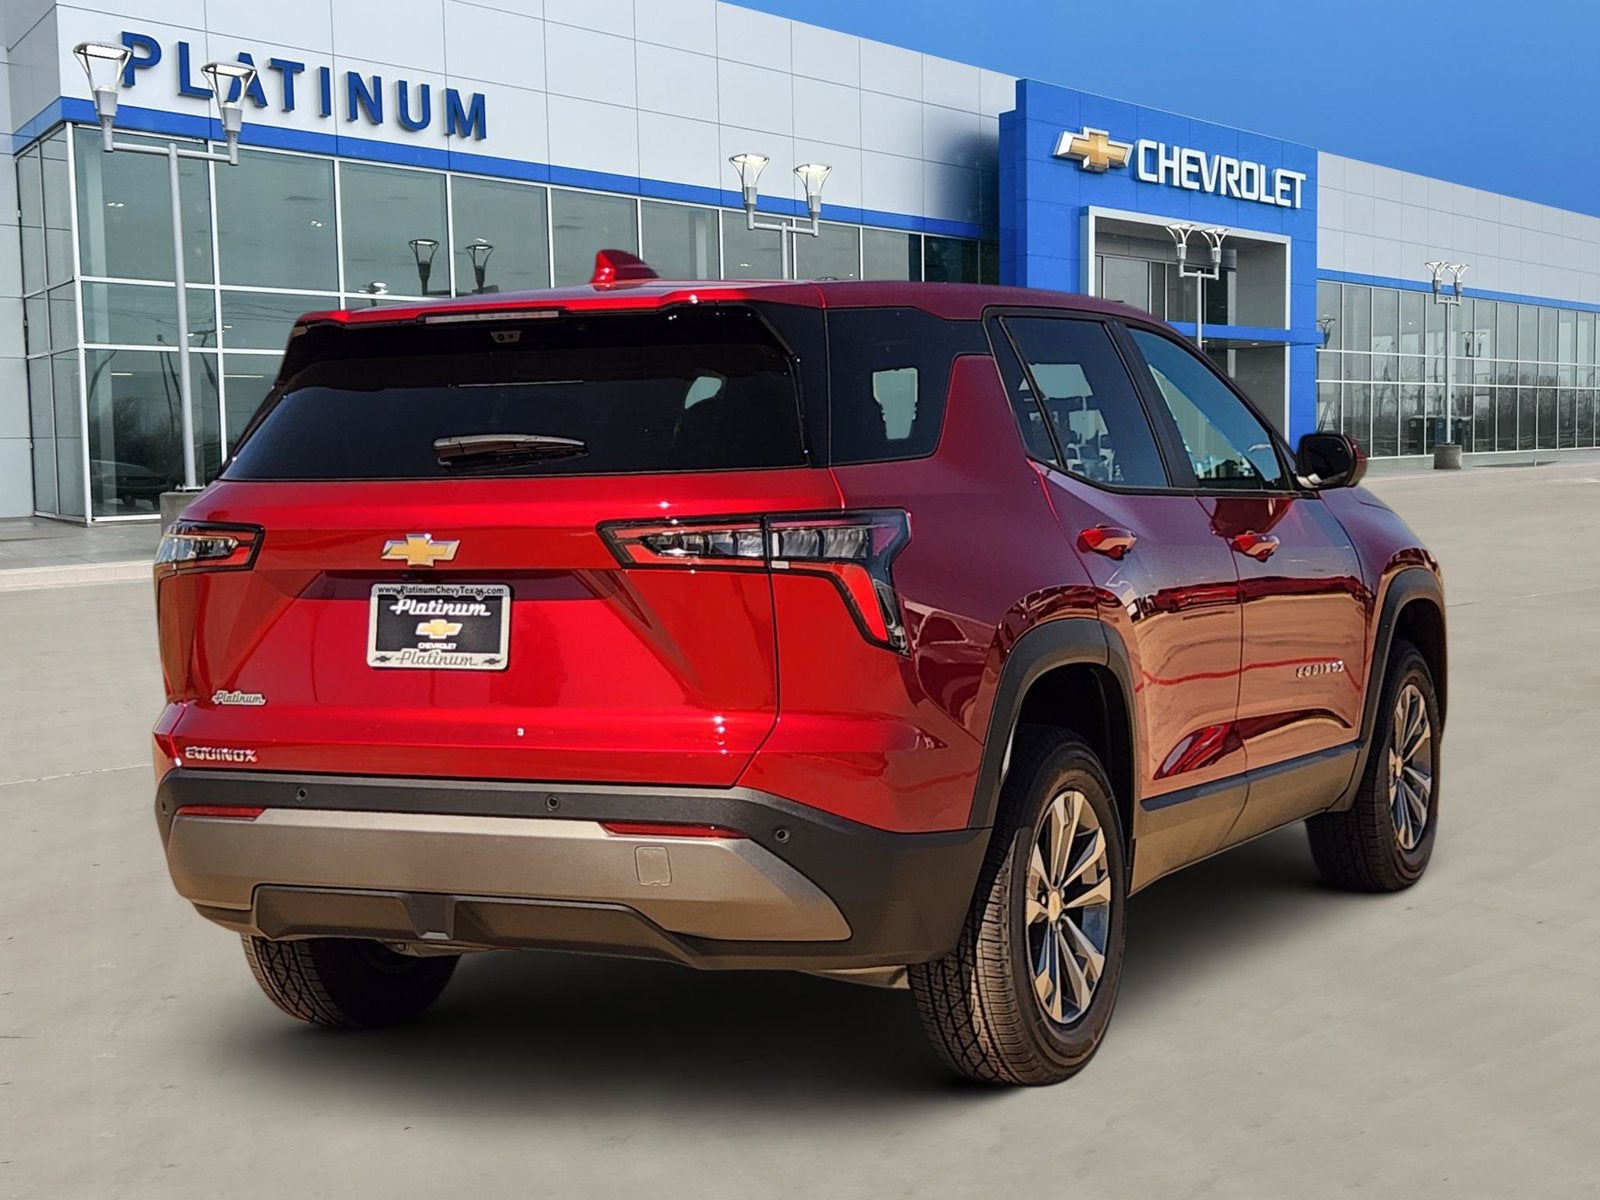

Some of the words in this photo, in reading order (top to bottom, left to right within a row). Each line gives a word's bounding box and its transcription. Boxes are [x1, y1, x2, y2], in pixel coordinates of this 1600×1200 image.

[120, 31, 488, 141] PLATINUM
[1136, 139, 1307, 209] CHEVROLET
[389, 599, 491, 616] Platinum
[395, 650, 478, 666] Platinum
[212, 690, 266, 705] Platinum
[185, 746, 258, 762] EQUINOX
